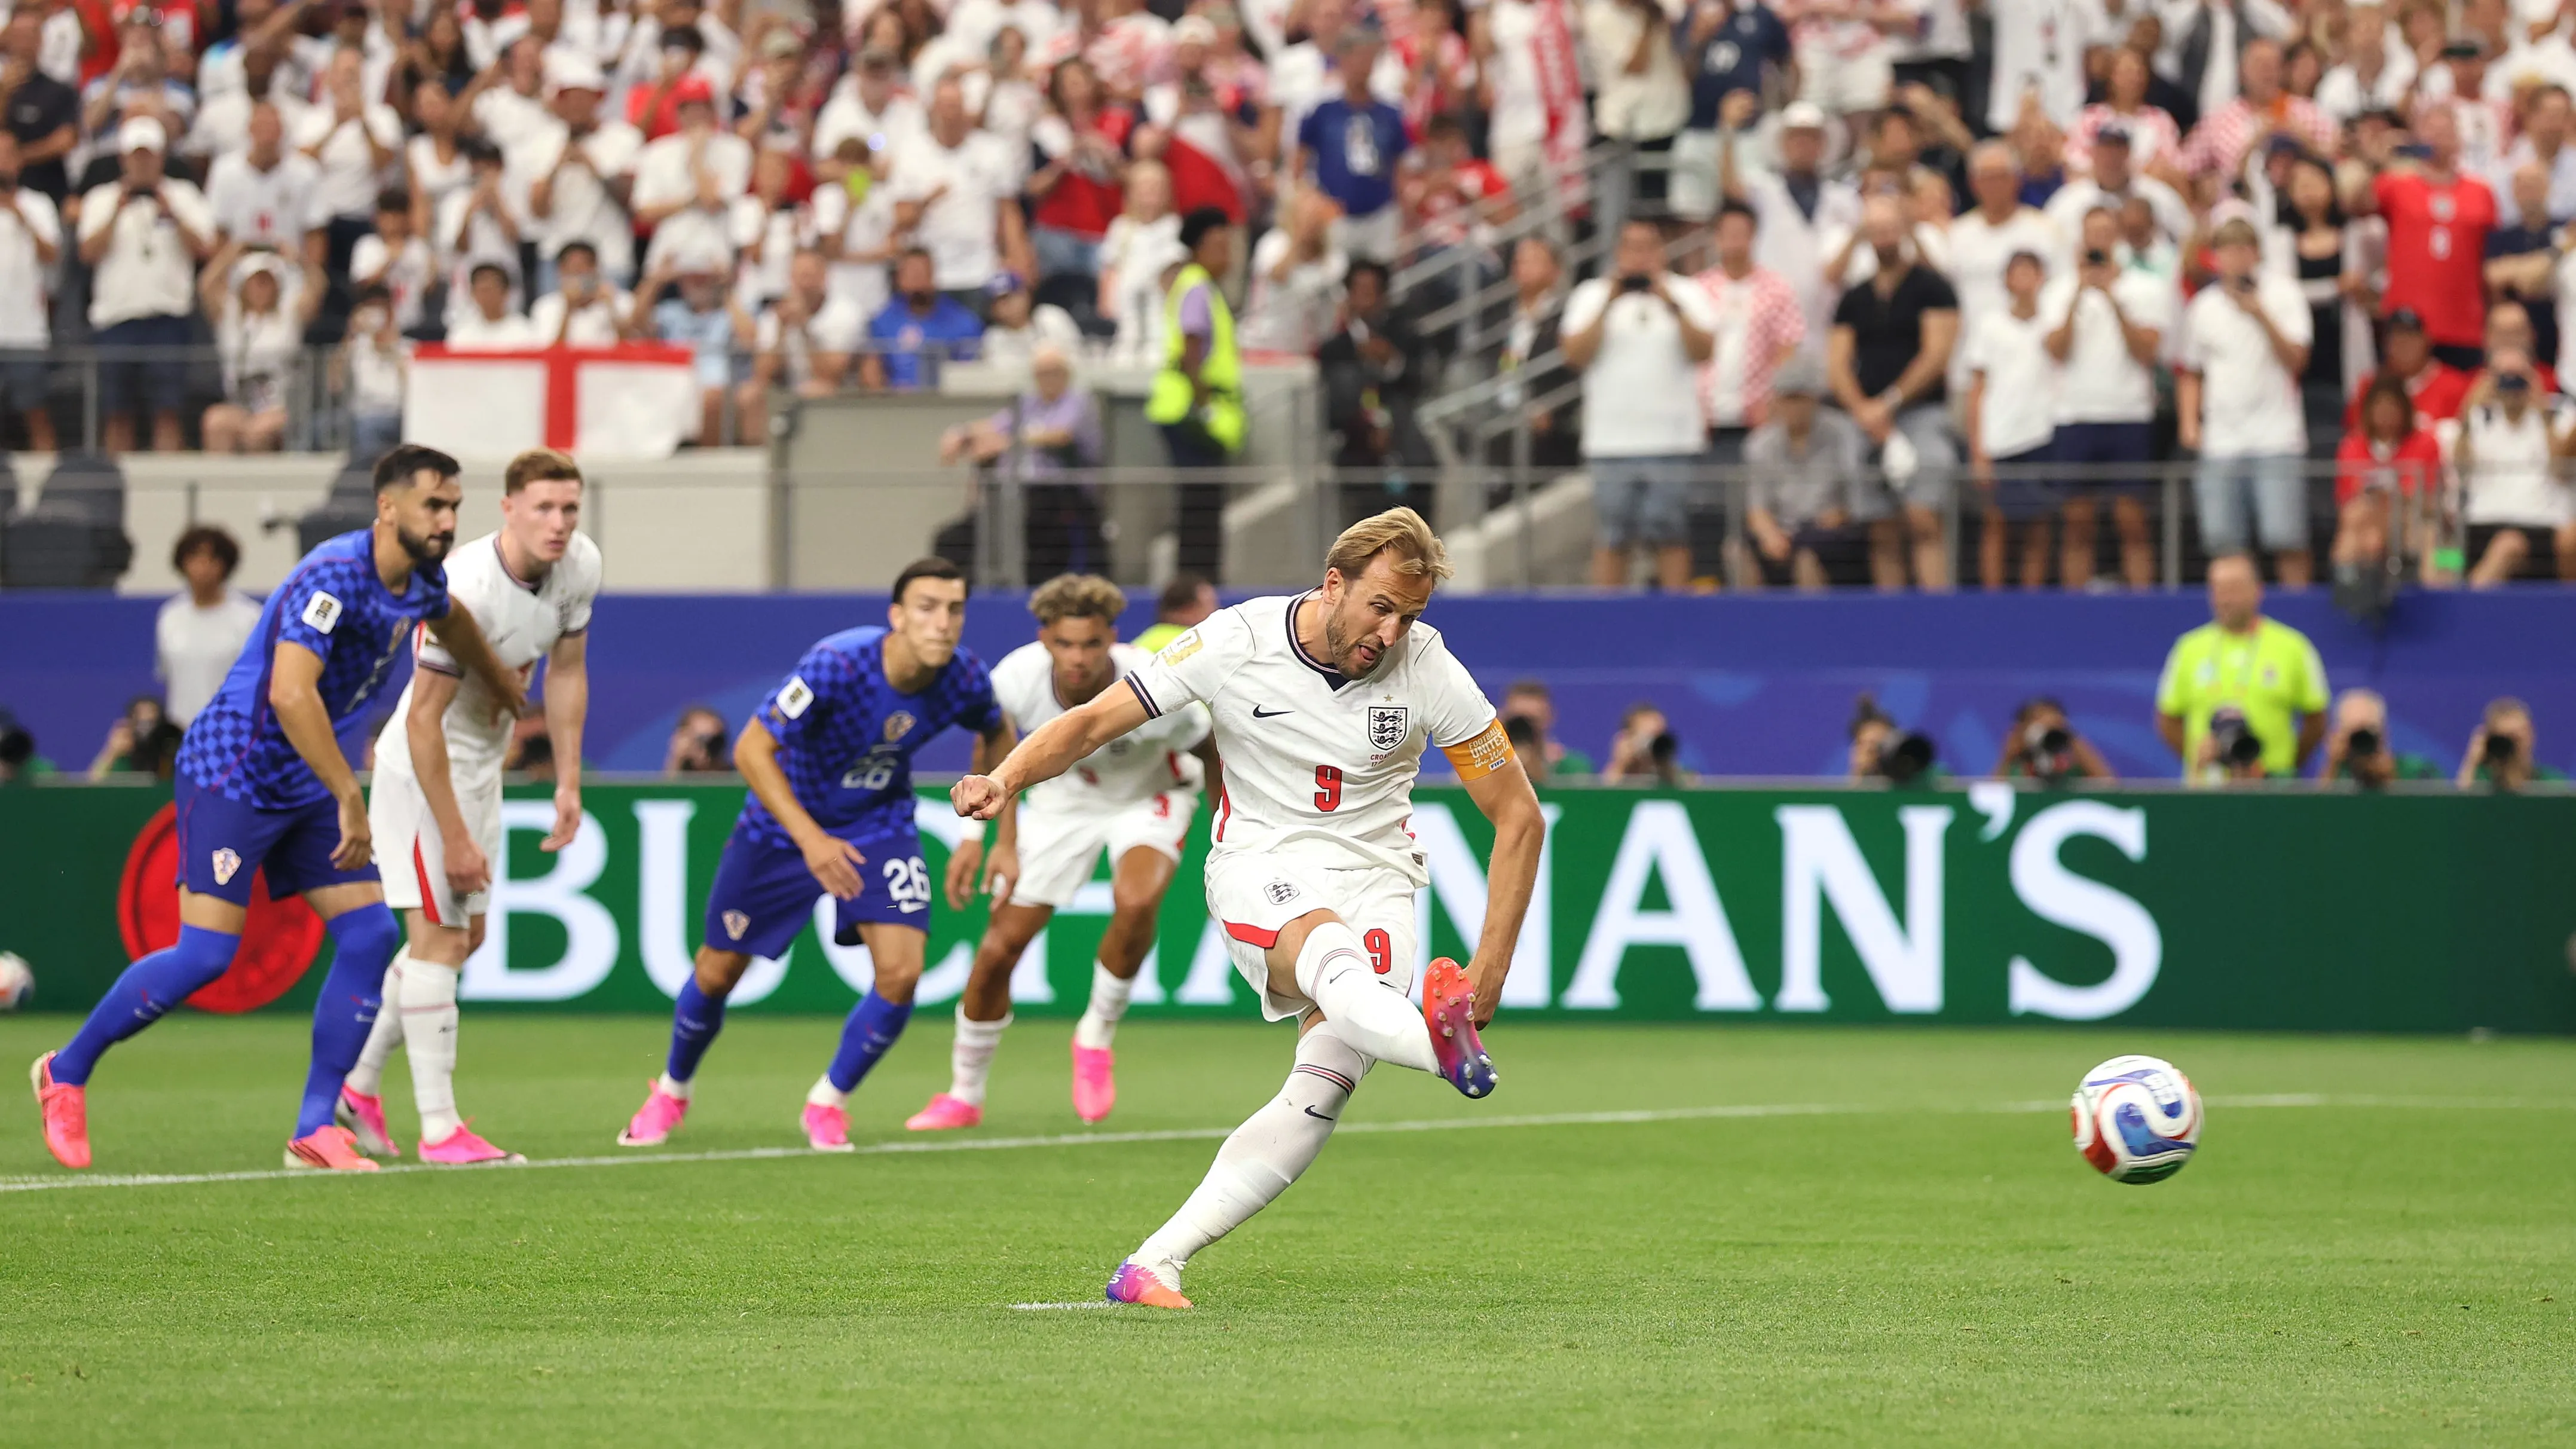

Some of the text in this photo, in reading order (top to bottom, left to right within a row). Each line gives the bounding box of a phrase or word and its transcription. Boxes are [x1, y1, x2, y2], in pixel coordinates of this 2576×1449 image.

[1468, 725, 1499, 749] FOOTBALL
[1470, 731, 1505, 759] UNITES
[841, 756, 898, 790] 26
[1474, 757, 1489, 768] the
[1491, 759, 1504, 769] FIFA
[1314, 765, 1342, 812] 9
[882, 855, 932, 902] 26
[1363, 928, 1391, 975] 9
